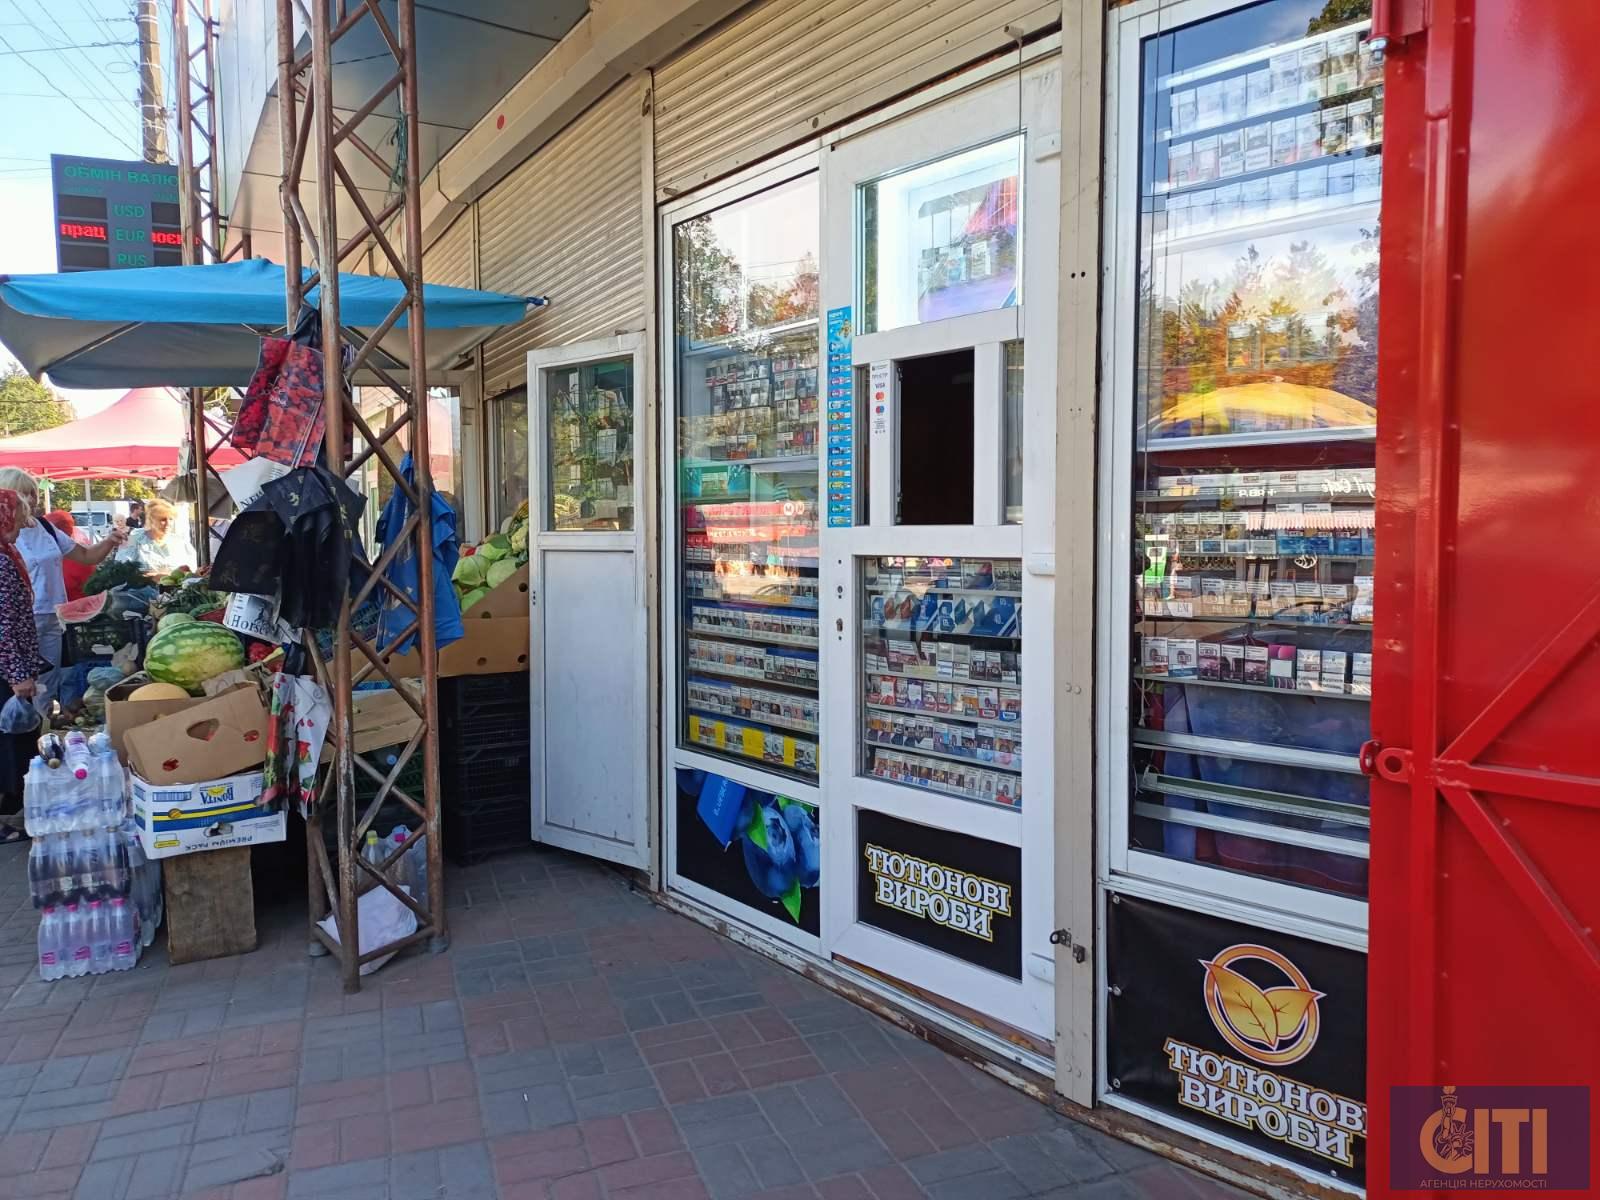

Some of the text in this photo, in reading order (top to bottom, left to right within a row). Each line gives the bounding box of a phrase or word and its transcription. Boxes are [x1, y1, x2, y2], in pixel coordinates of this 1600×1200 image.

[63, 165, 179, 187] ОБМІН ВАЛЮ
[113, 203, 145, 218] USD
[115, 228, 145, 242] EUR
[117, 252, 146, 266] RUS
[185, 836, 253, 851] PREMIUM PACK
[866, 845, 1010, 914] ТЮТЮНОВІ
[877, 875, 992, 940] ВИРОБИ
[1180, 1074, 1351, 1165] ВИРОБИ
